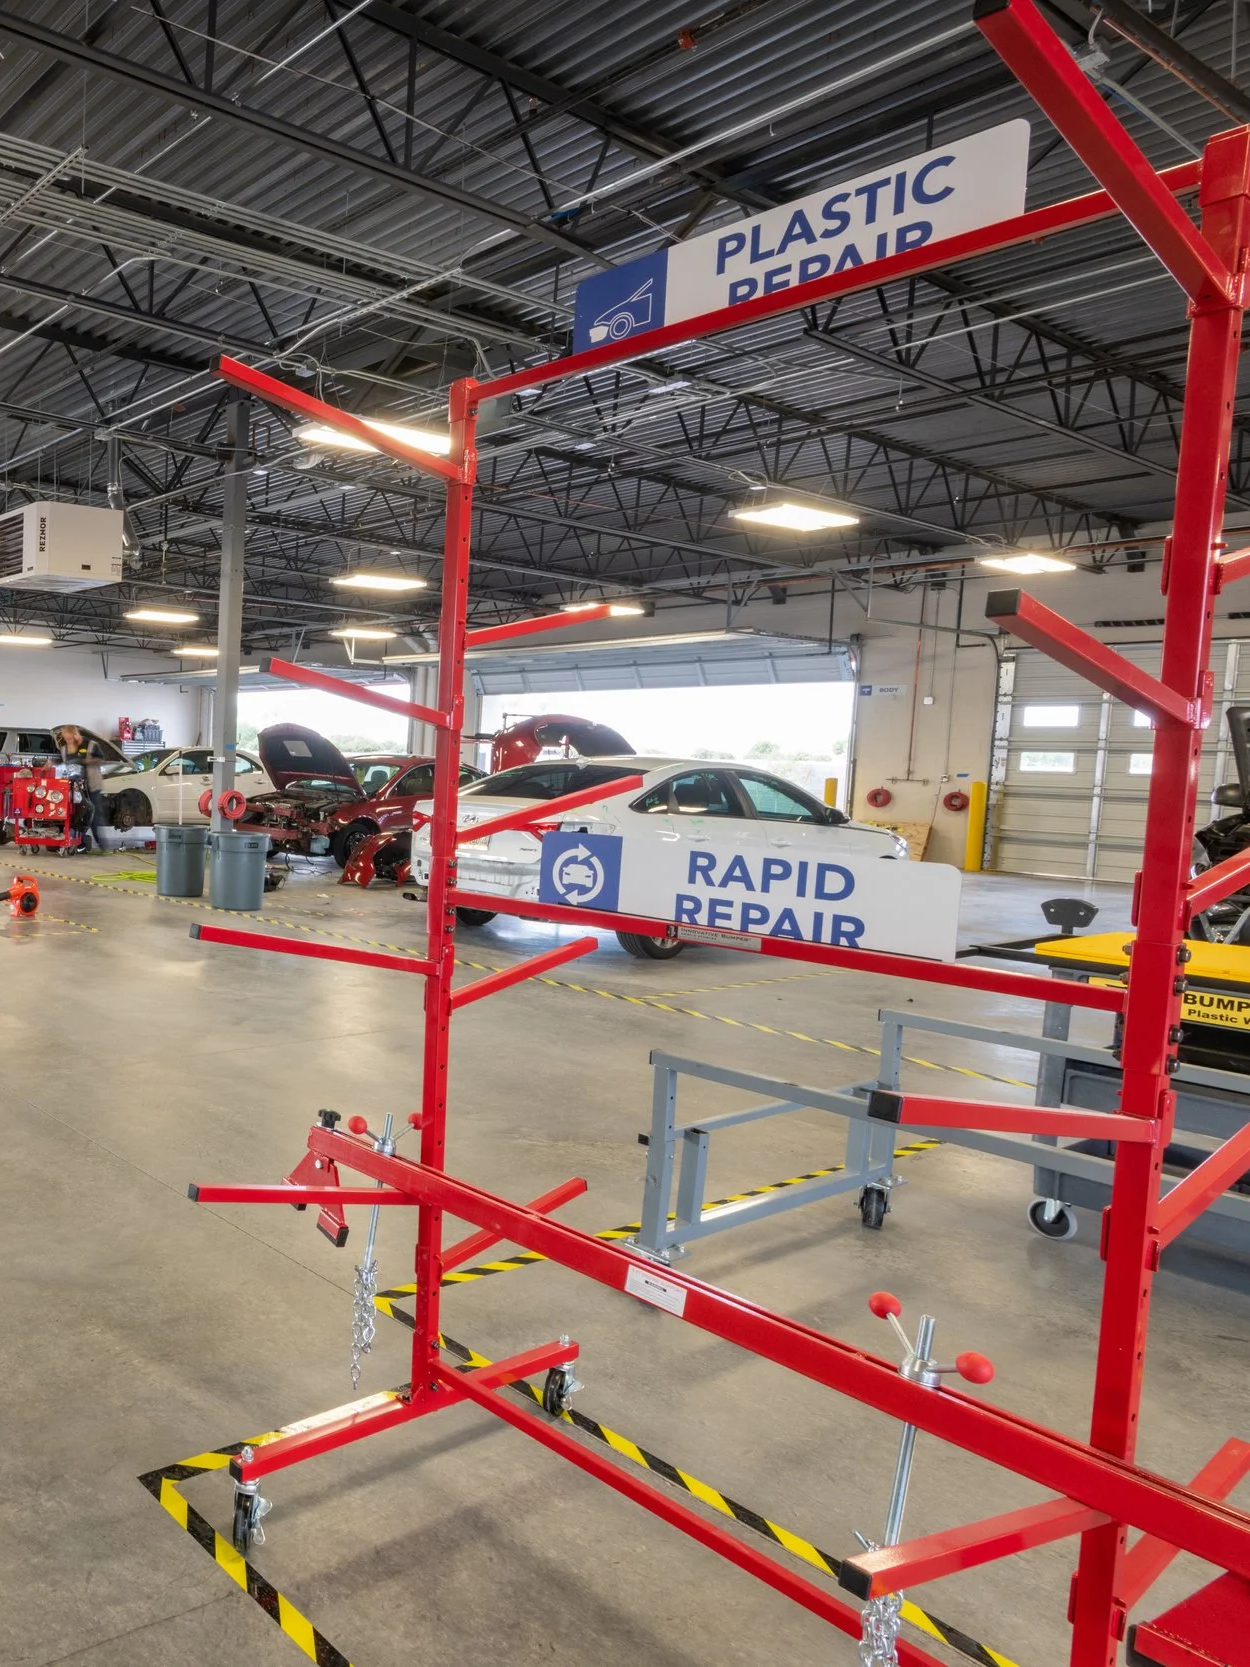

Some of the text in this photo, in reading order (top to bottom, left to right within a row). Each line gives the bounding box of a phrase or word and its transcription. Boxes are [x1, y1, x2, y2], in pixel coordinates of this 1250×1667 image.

[716, 155, 956, 276] PLASTIC
[39, 517, 47, 552] REZNOR
[687, 850, 856, 901] RAPID
[674, 893, 866, 947] REPAIR
[680, 927, 718, 938] INNOVATIVE
[1188, 1008, 1238, 1023] Plastic
